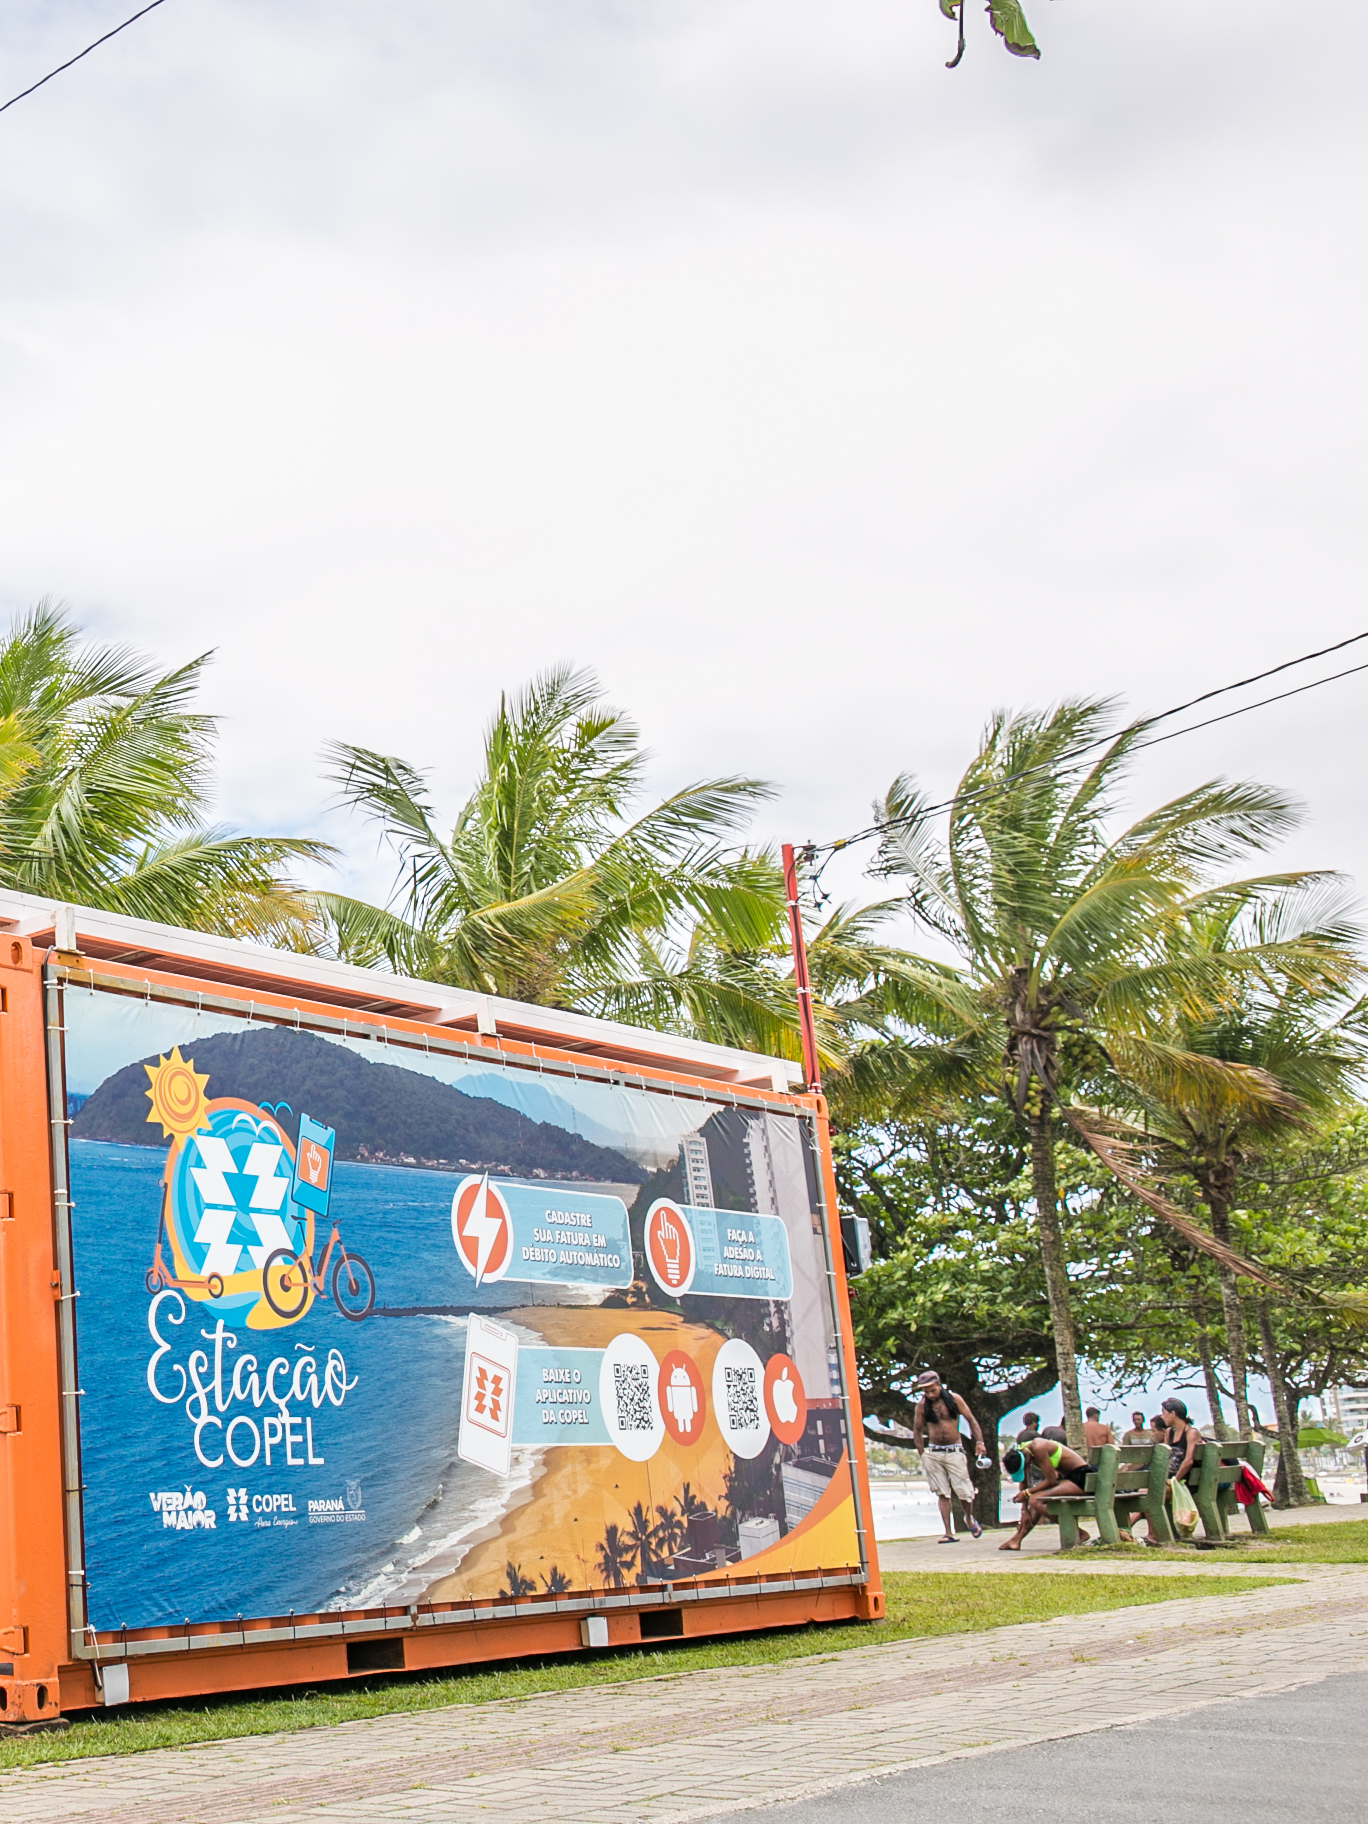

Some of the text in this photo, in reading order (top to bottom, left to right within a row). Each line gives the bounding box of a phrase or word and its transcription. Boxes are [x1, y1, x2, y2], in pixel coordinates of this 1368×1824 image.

[545, 1209, 592, 1228] CADASTRE
[533, 1227, 607, 1248] SUA FATURA EM
[727, 1228, 755, 1246] FAÇA A
[521, 1243, 621, 1268] DÉBITO AUTOMÁTICO
[723, 1244, 755, 1262] ADESÃO
[714, 1262, 776, 1281] FATURA DIGITAL
[146, 1289, 359, 1424] Estação
[542, 1368, 581, 1384] BAIXE O
[536, 1388, 592, 1404] APLICATIVO
[541, 1409, 589, 1424] DA COPEL
[193, 1415, 325, 1468] COPEL
[149, 1483, 207, 1512] VERÃO
[252, 1493, 297, 1513] COPEL
[308, 1496, 345, 1512] PARANÁ
[162, 1509, 217, 1530] MAIOR
[309, 1513, 367, 1524] GOVERNO DO ESTADO
